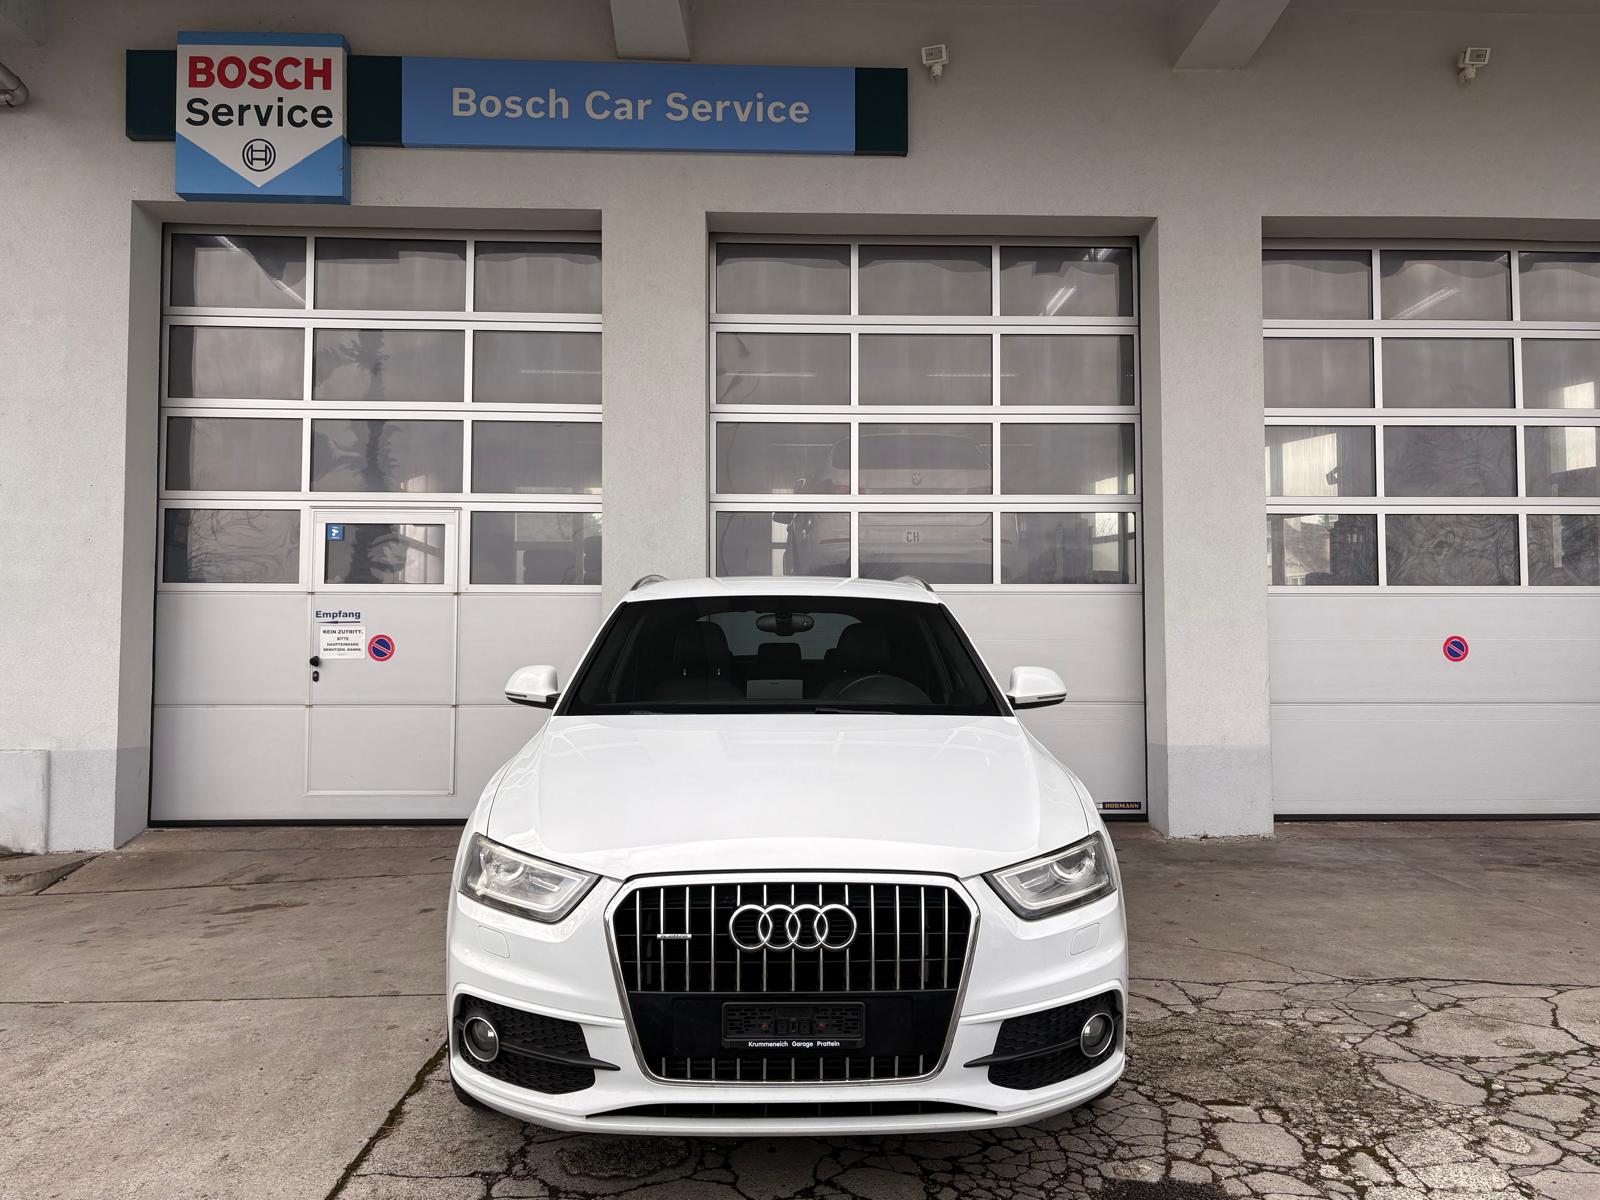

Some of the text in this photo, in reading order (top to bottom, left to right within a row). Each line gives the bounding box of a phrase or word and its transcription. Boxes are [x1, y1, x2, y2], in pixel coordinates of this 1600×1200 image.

[188, 55, 333, 91] BOSCH
[184, 96, 334, 130] Service
[451, 86, 811, 124] Bosch Car Service
[906, 531, 920, 543] CH
[315, 610, 361, 620] Empfang
[748, 1040, 789, 1048] Krummeneich
[791, 1040, 814, 1049] Garage
